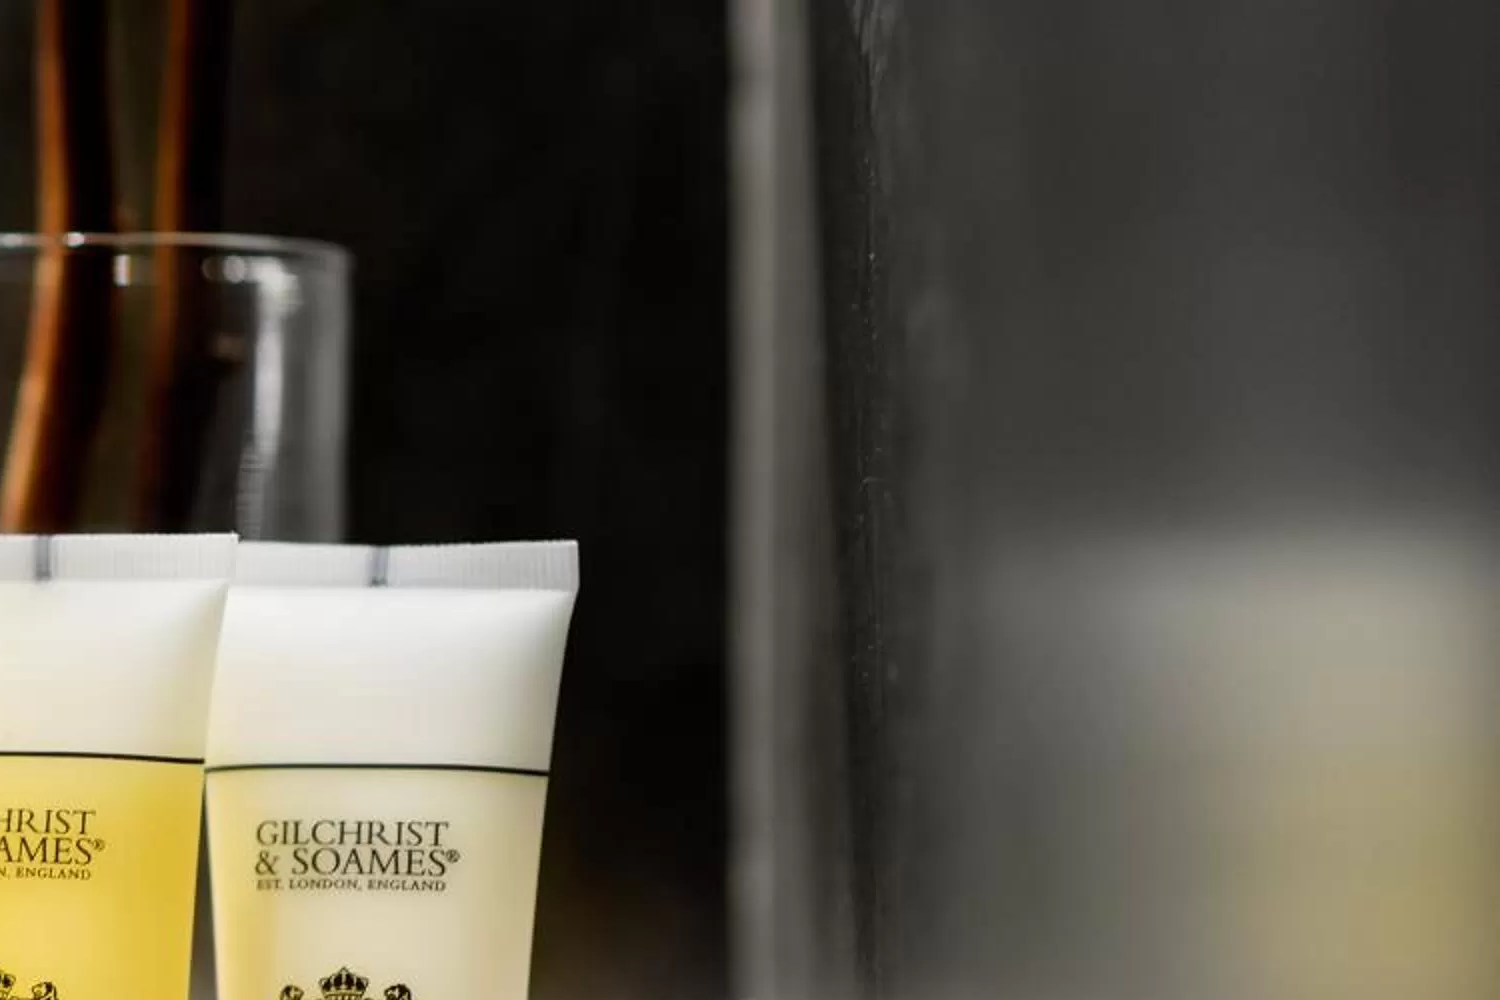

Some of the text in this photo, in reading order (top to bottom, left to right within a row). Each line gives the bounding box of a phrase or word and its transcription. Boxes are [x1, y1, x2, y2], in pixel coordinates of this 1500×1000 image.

[256, 820, 449, 847] GILCHRIST
[255, 850, 280, 875] &
[16, 867, 92, 881] ENGLAND
[367, 879, 446, 893] ENGLAND
